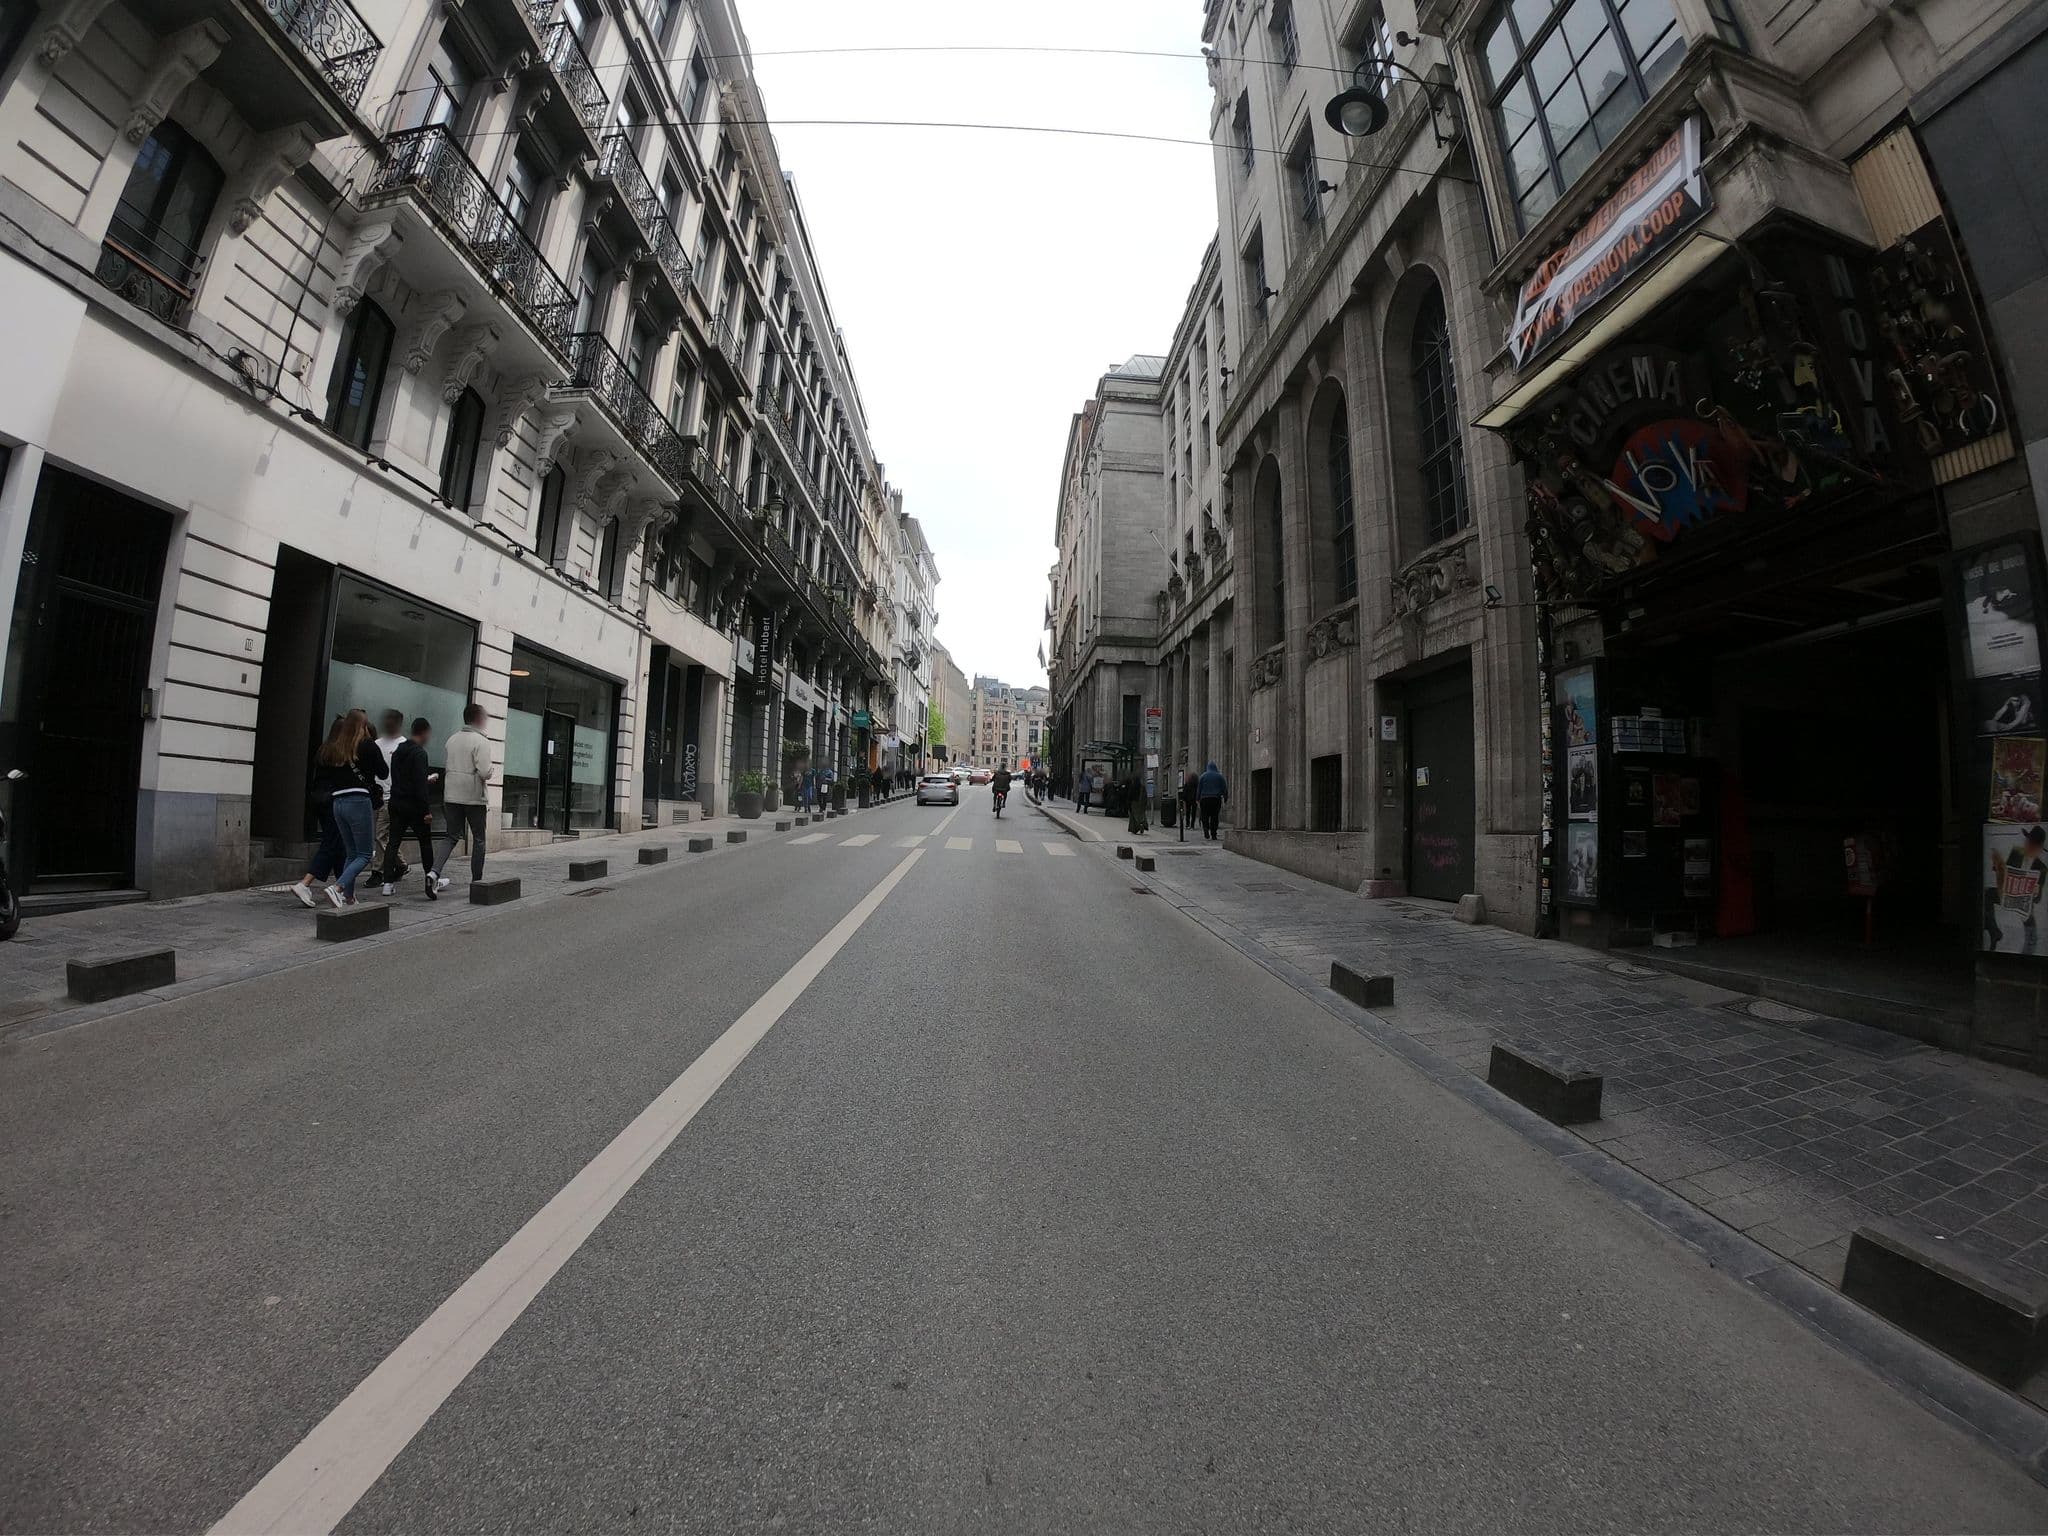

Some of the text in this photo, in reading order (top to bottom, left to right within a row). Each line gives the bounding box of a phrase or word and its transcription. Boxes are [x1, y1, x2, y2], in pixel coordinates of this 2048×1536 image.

[1827, 251, 1891, 454] NOVA
[1569, 355, 1682, 447] CINEMA
[1602, 440, 1728, 524] NOVA
[758, 654, 767, 683] Hotel
[760, 617, 771, 652] Hubert
